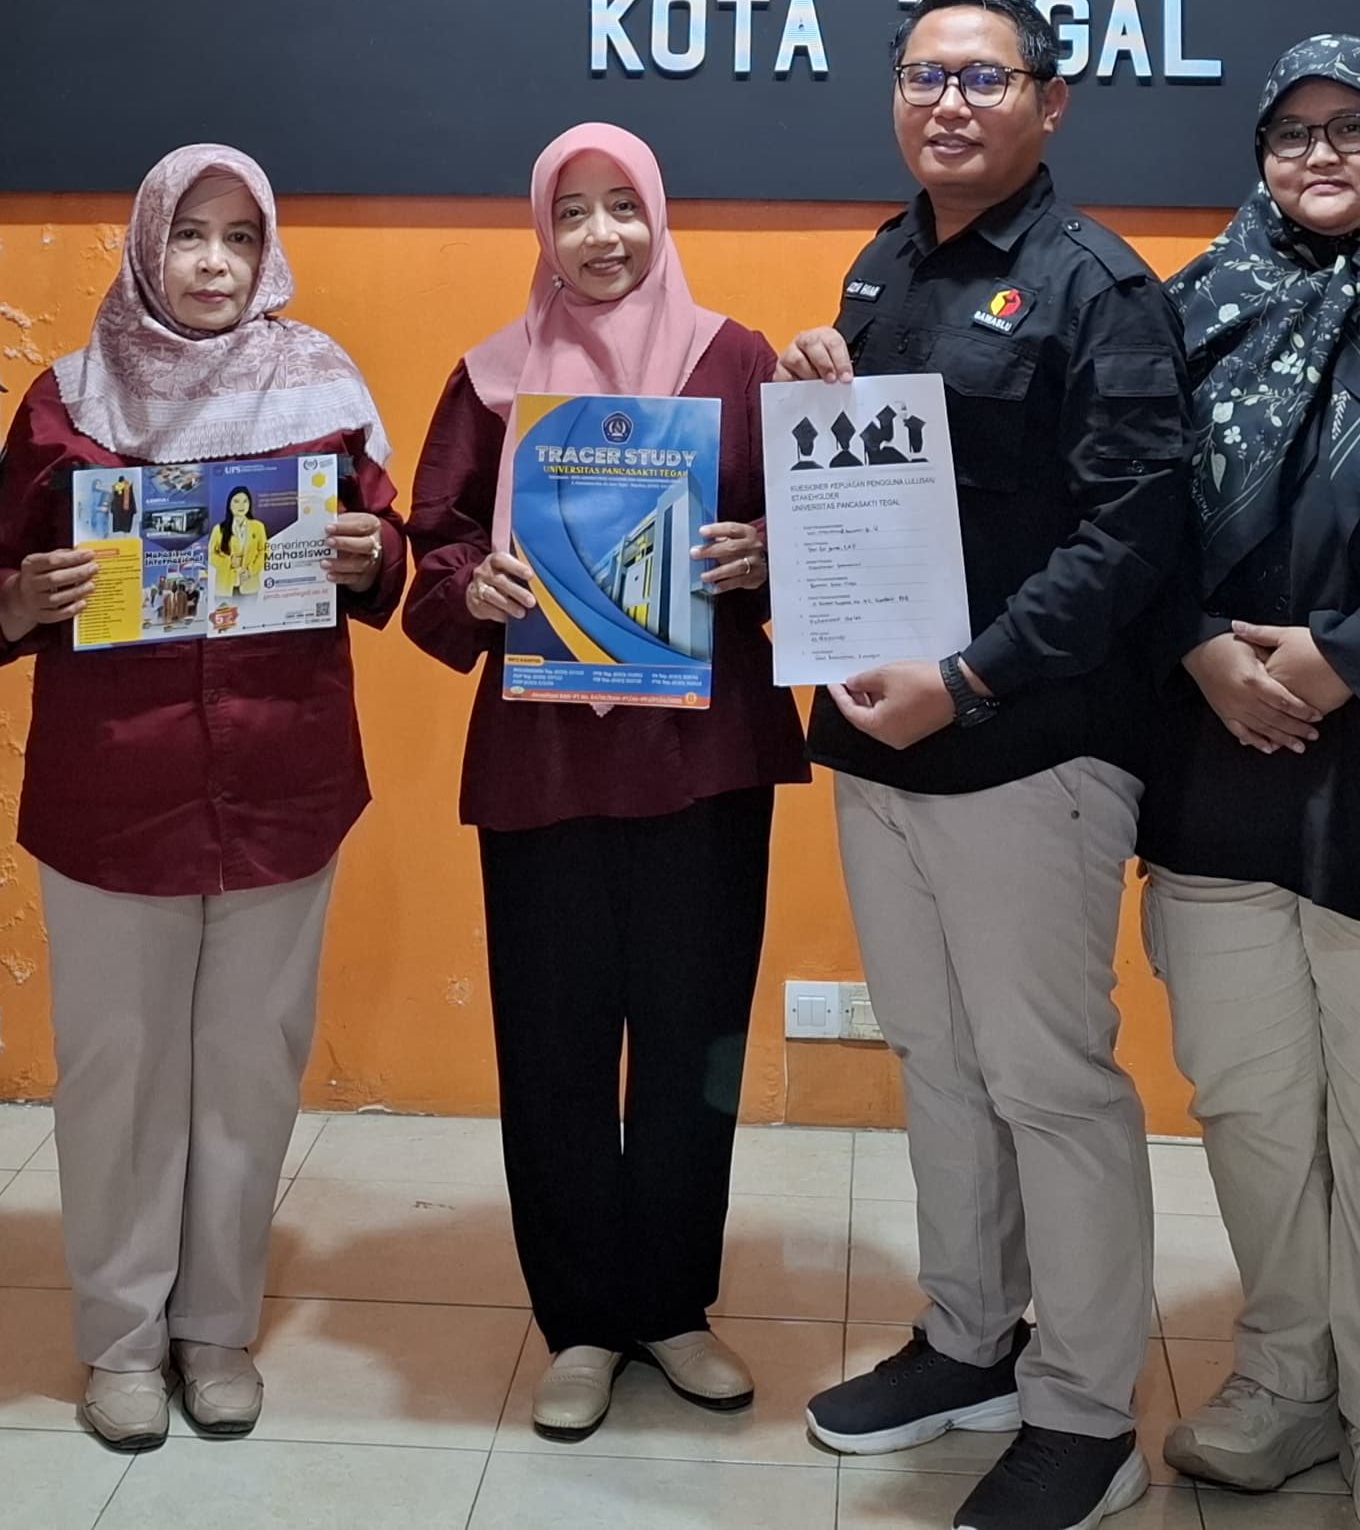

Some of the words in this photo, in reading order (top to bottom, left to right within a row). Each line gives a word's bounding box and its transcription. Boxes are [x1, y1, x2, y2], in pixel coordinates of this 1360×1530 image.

[974, 310, 1013, 332] BAWASLU
[535, 445, 620, 464] TRACER
[624, 449, 697, 467] STUDY
[543, 465, 600, 474] UNIVERSITAS
[602, 467, 658, 476] PANCASAKTI
[263, 539, 325, 551] Penerimaa
[264, 548, 332, 562] Mahasiswa
[264, 561, 291, 571] Baru
